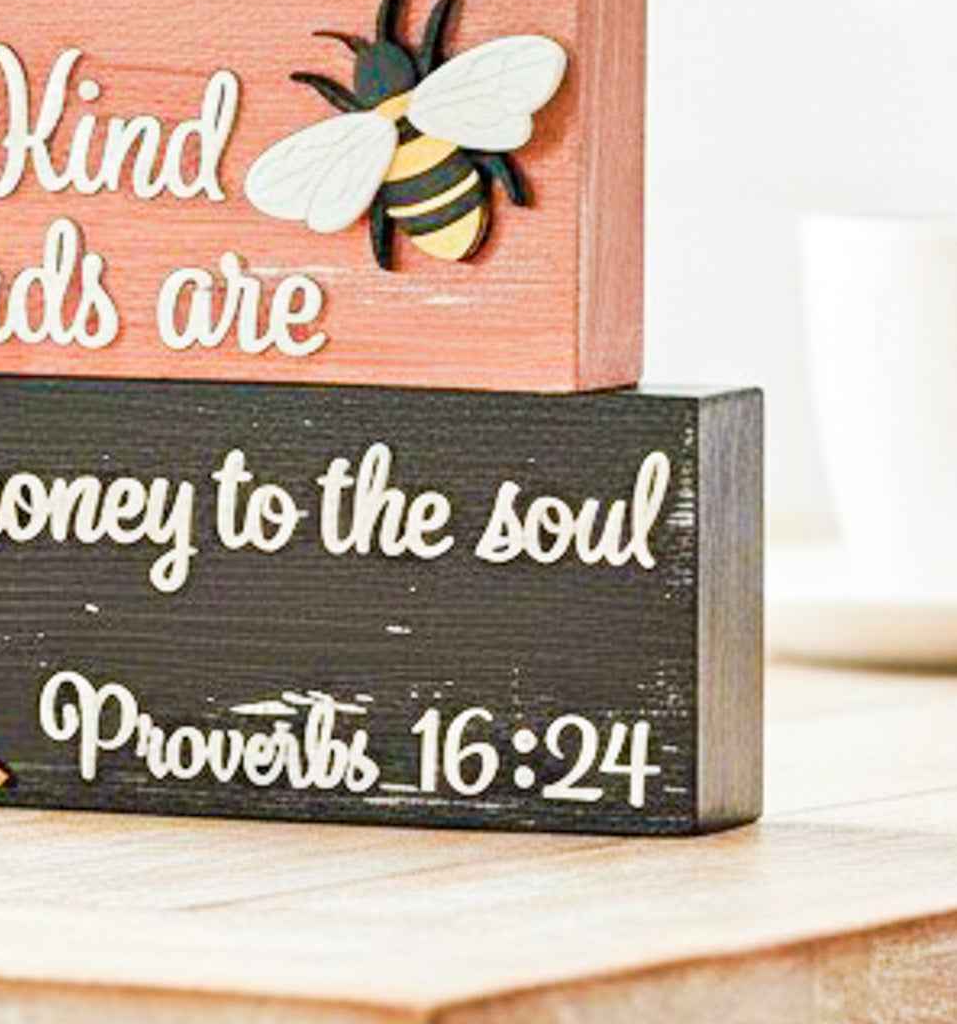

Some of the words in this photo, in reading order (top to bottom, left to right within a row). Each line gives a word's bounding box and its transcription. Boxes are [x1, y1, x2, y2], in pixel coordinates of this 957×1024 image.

[155, 251, 327, 357] are
[212, 449, 307, 554] to
[317, 442, 455, 561] the
[474, 451, 672, 570] soul
[38, 670, 380, 794] Proverbs
[411, 706, 659, 808] 16:24
